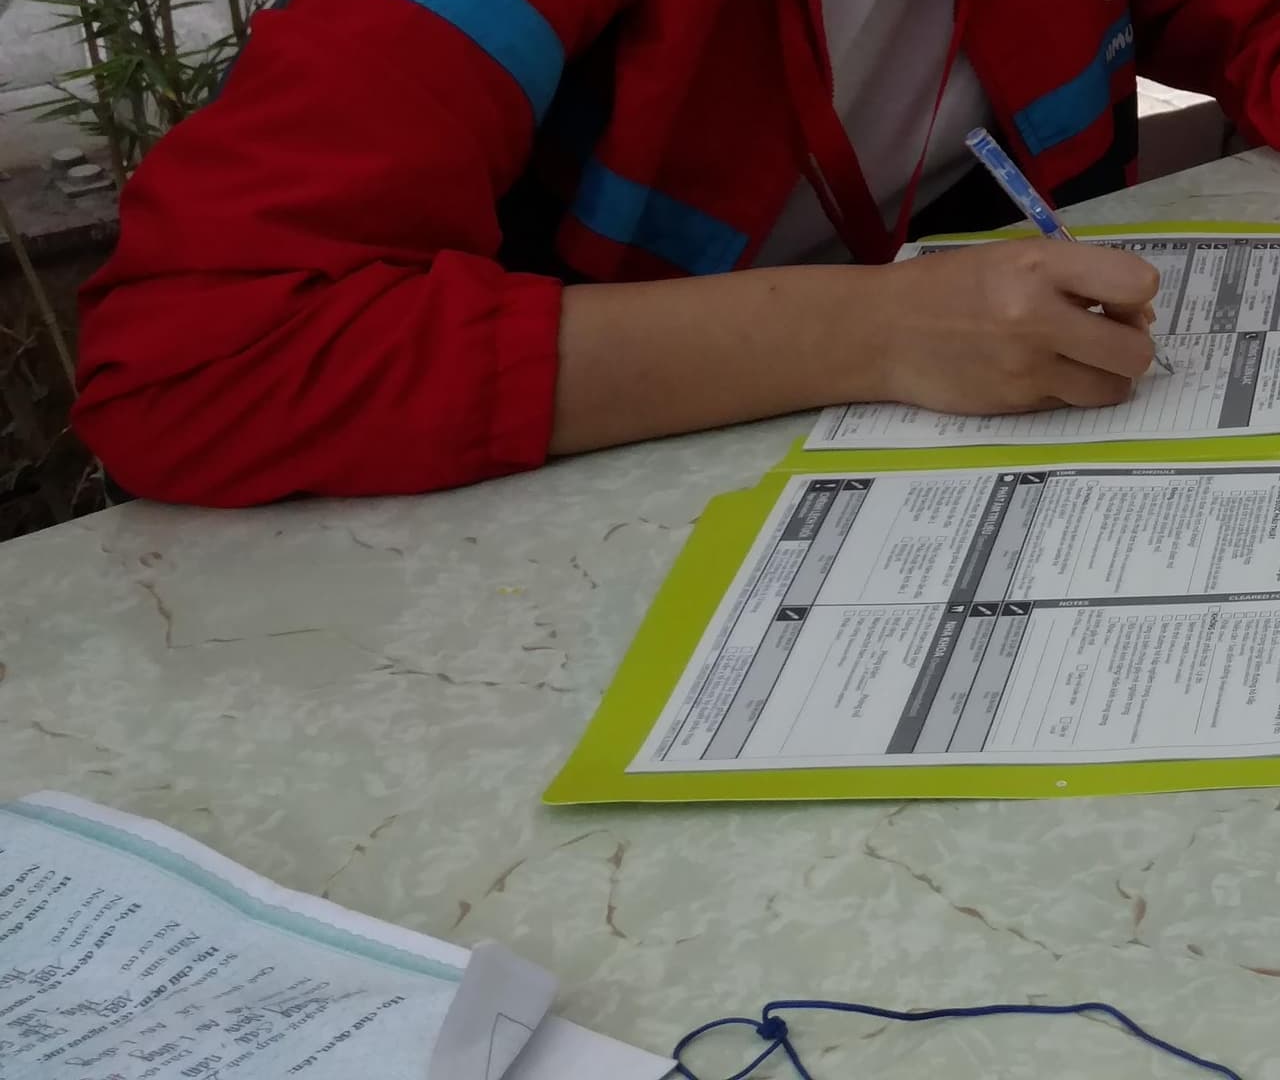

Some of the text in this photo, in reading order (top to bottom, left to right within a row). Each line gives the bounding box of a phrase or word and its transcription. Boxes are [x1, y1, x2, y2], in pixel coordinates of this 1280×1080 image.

[1229, 593, 1268, 601] CLEARED
[931, 621, 957, 656] NHA KHOA
[169, 964, 193, 986] chữ
